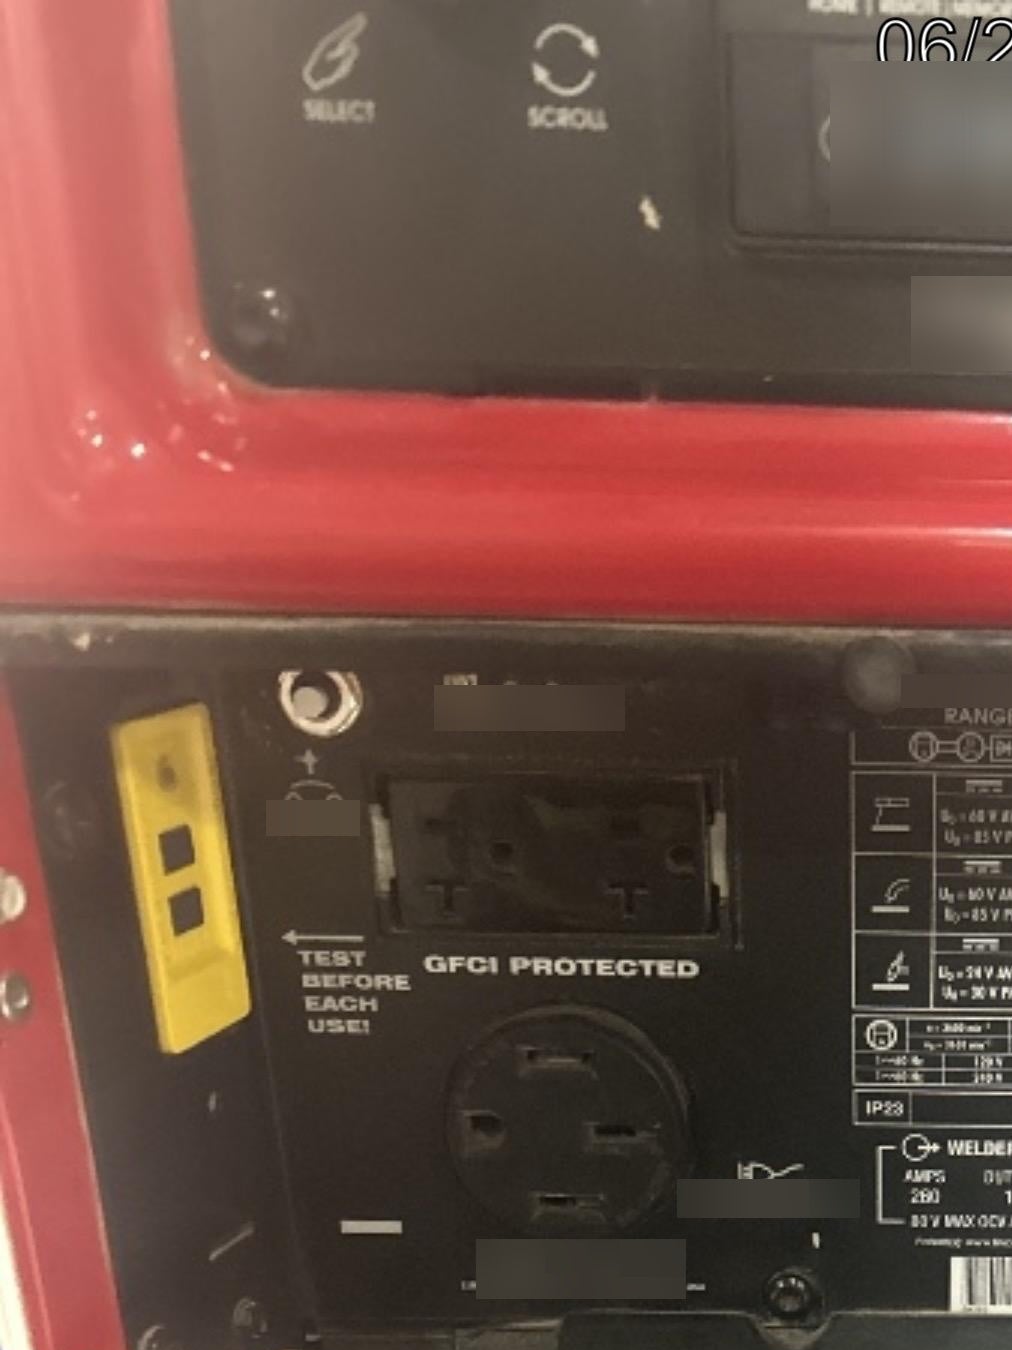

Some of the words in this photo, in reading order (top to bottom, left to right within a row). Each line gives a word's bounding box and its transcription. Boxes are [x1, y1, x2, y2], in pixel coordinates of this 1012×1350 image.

[527, 105, 608, 131] SCROLL
[298, 950, 366, 967] TEST
[424, 954, 498, 973] GFCI
[509, 957, 700, 978] PROTECTED
[302, 974, 411, 990] BEFORE
[304, 996, 378, 1012] EACH
[308, 1019, 369, 1034] USE!
[905, 1169, 946, 1183] AMPS
